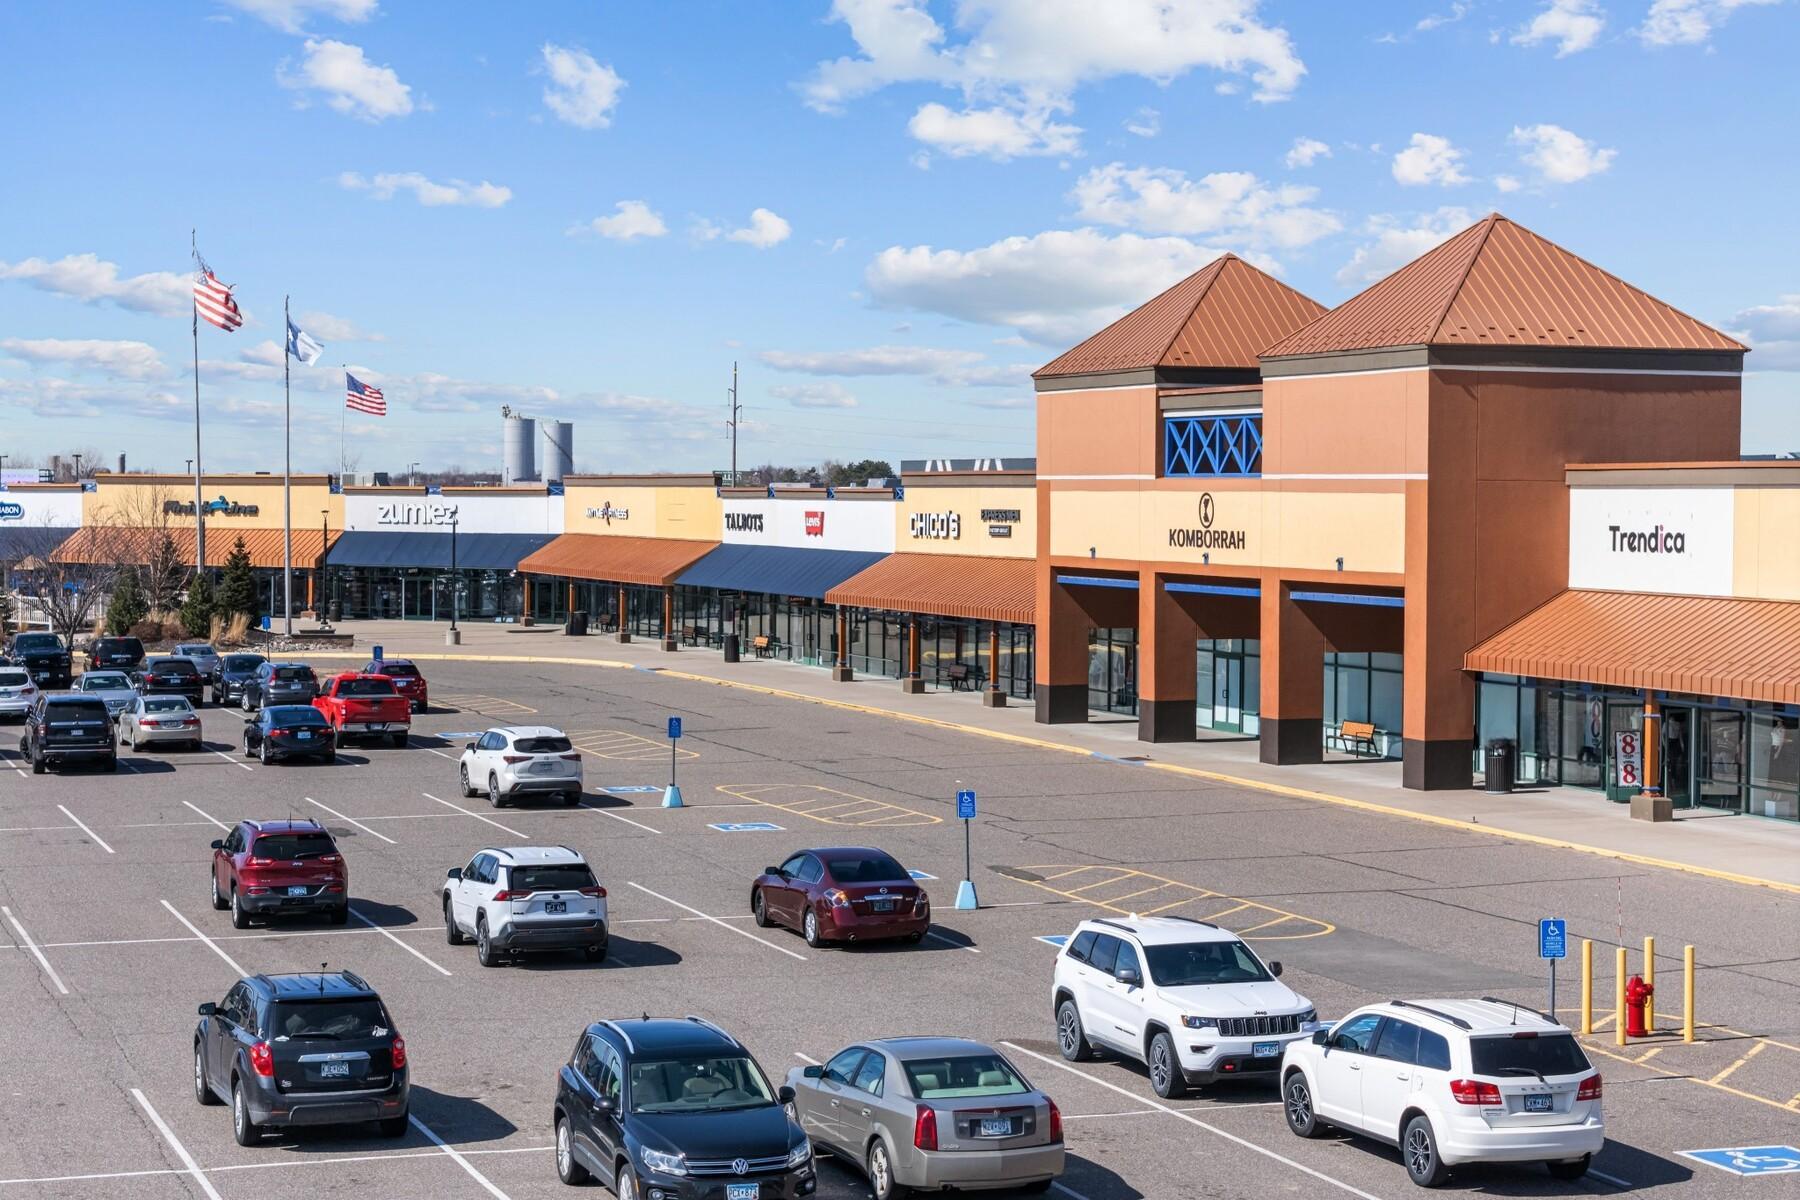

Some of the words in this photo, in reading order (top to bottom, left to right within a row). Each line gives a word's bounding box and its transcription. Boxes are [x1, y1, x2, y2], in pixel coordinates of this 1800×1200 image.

[725, 513, 763, 532] TALBOTS
[909, 510, 960, 540] CHICO'S
[1169, 528, 1245, 550] KOMBORRAH
[1609, 524, 1685, 554] Trendica
